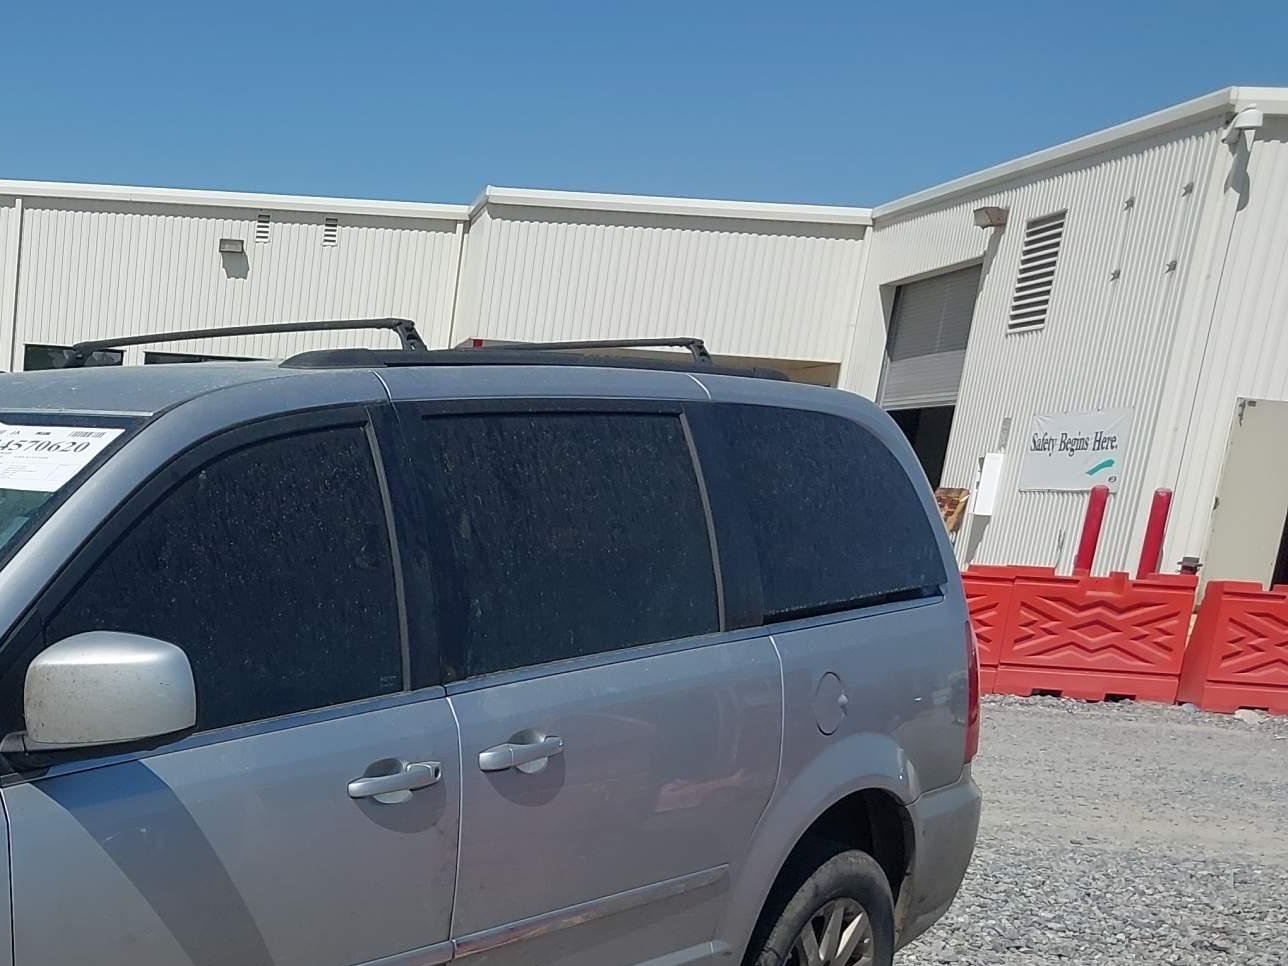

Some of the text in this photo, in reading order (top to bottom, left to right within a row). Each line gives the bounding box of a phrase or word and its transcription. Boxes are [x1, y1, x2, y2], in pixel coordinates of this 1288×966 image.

[1030, 431, 1118, 456] Safety Begins Here.
